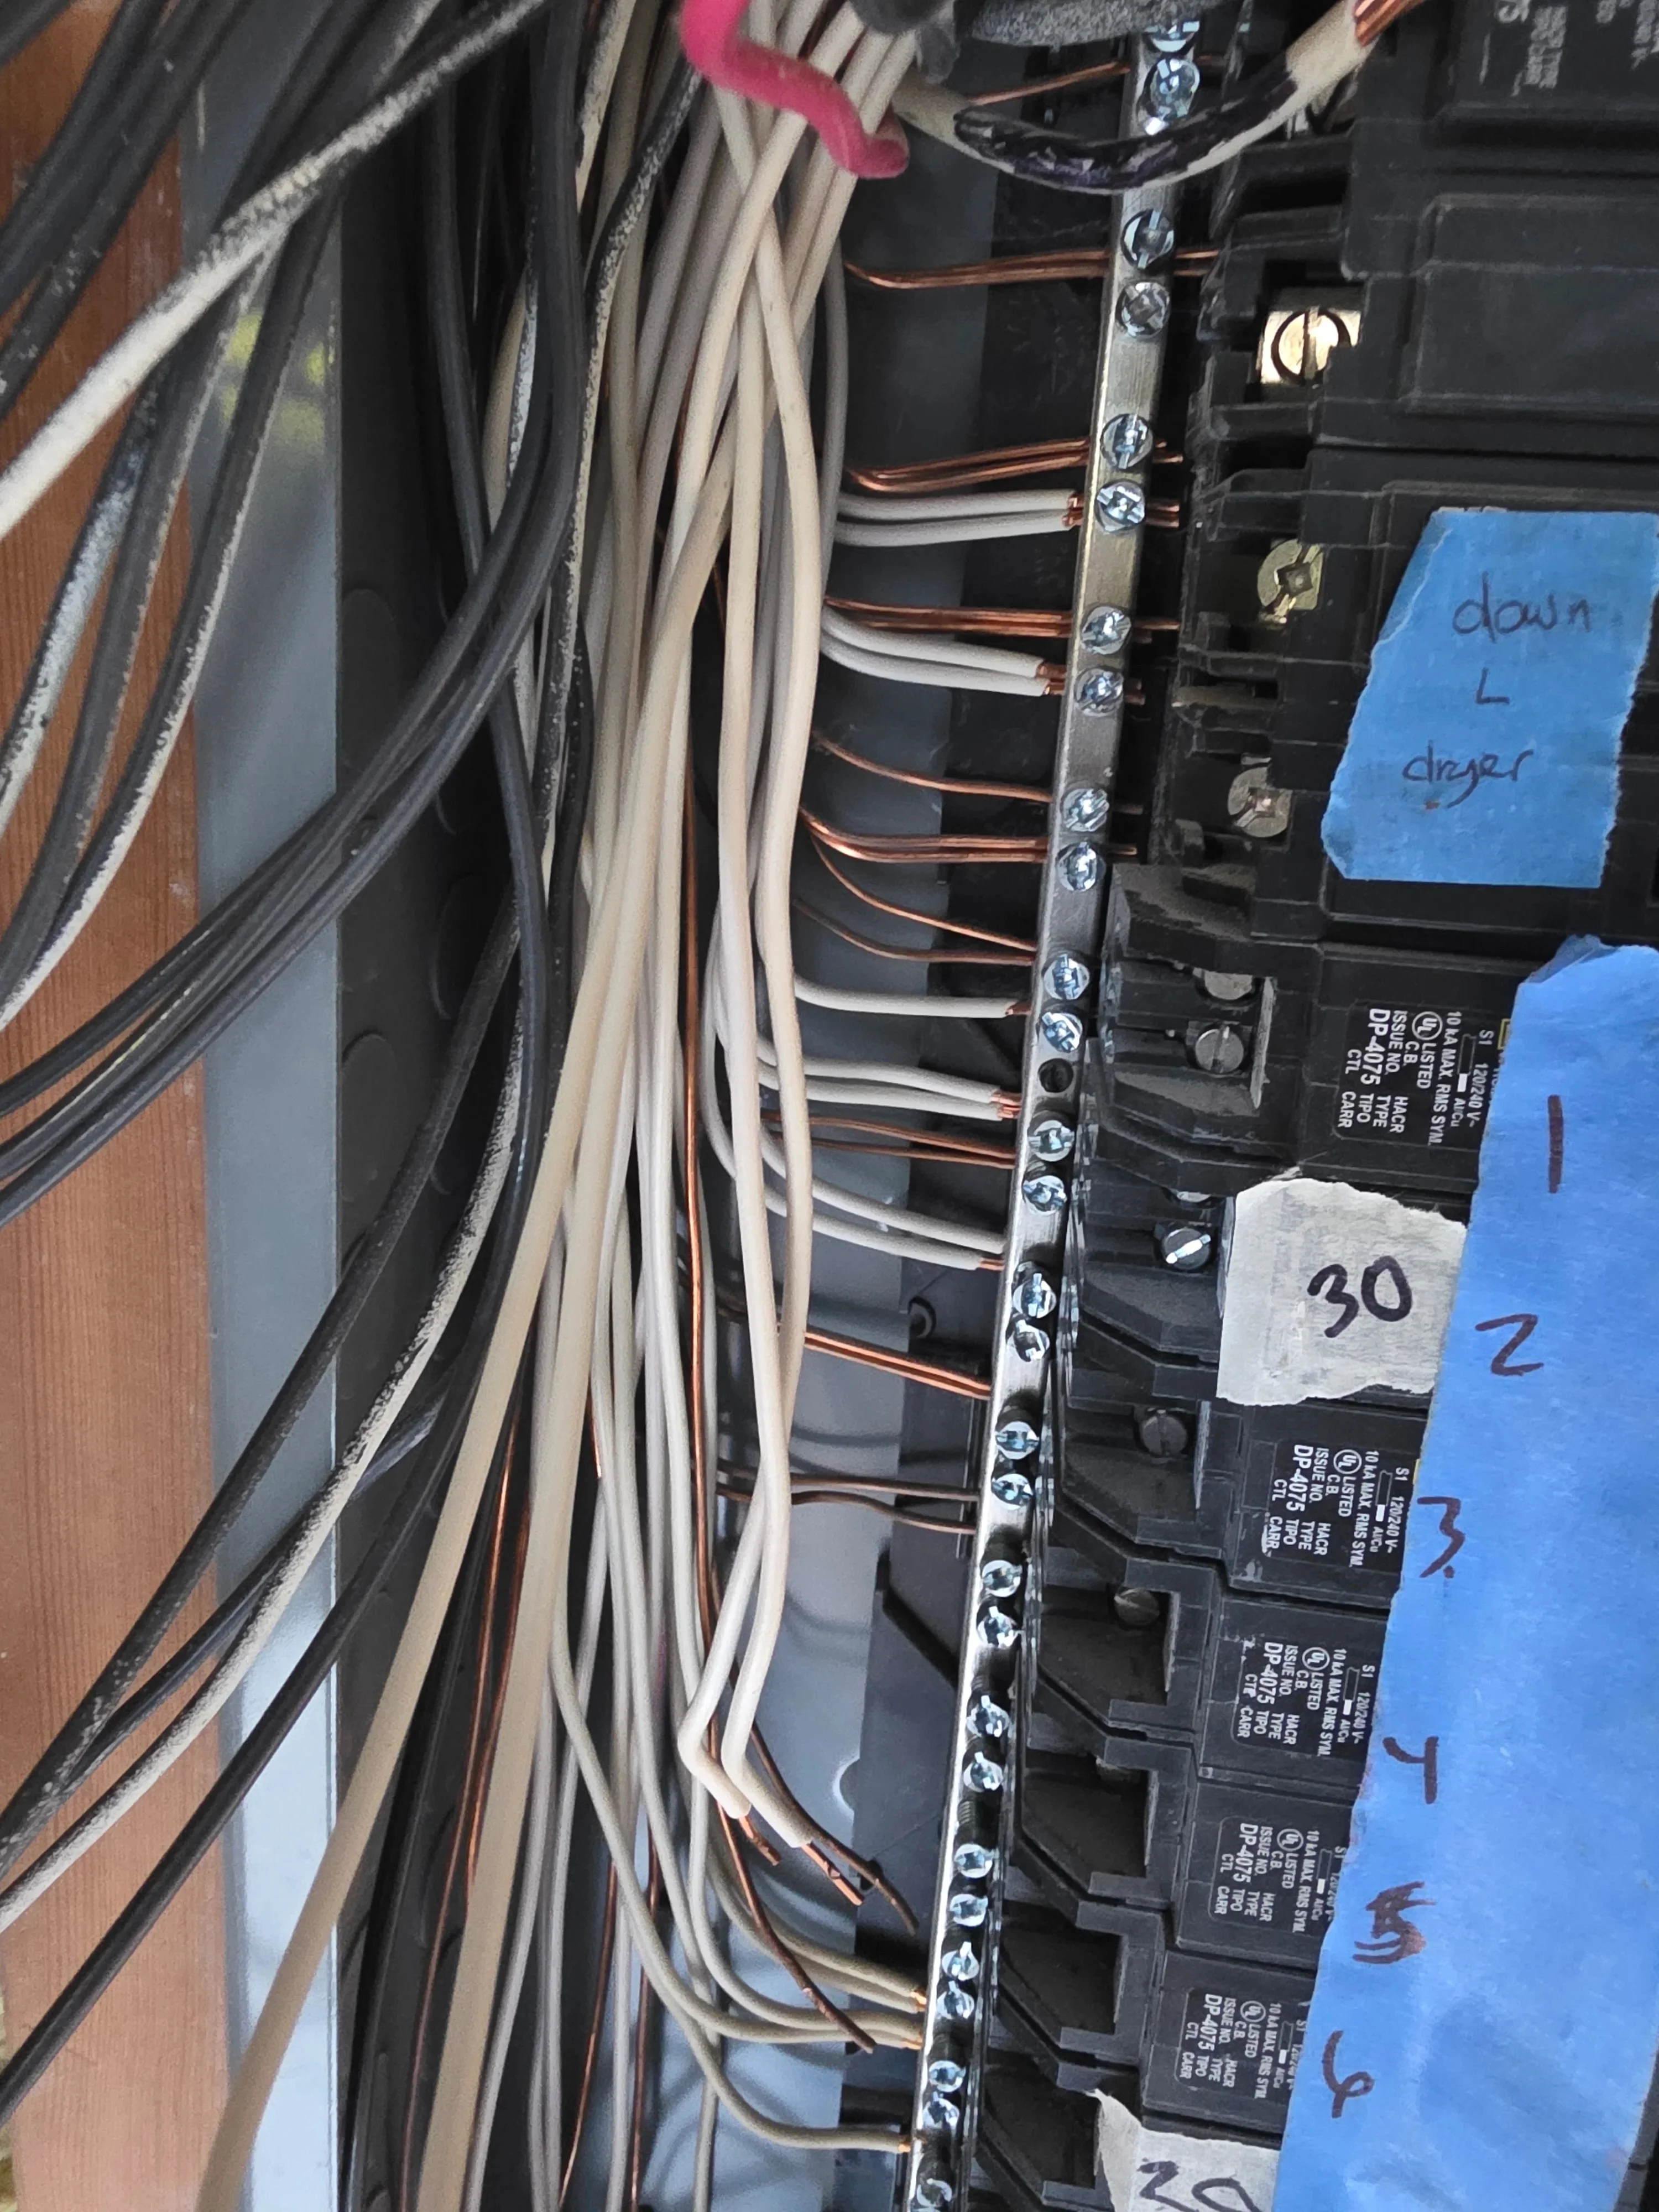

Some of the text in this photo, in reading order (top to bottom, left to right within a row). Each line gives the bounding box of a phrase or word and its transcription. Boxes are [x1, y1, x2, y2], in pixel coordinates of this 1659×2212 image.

[1452, 572, 1592, 644] down
[1475, 667, 1510, 704] L
[1402, 739, 1535, 809] dryer
[1389, 1010, 1407, 1050] ISSUE
[1447, 1011, 1462, 1025] 10
[1360, 1009, 1391, 1085] DP-4075
[1443, 1029, 1459, 1046] kA
[1479, 1030, 1494, 1045] S1
[1345, 1049, 1362, 1074] CTL
[1404, 1041, 1420, 1066] C.B.
[1417, 1043, 1437, 1089] LISTED
[1433, 1084, 1452, 1112] RMS
[1468, 1063, 1489, 1109] 120/240
[1338, 1092, 1357, 1128] CARR
[1357, 1093, 1375, 1123] TIPO
[1373, 1095, 1391, 1128] TYPE
[1390, 1097, 1408, 1133] HACR
[1307, 1255, 1413, 1338] 30
[1475, 1313, 1544, 1376] 2
[1312, 1448, 1329, 1481] ISSUE
[1365, 1451, 1379, 1463] 10
[1286, 1444, 1314, 1512] DP-4075
[1325, 1474, 1341, 1496] C.B.
[1363, 1465, 1378, 1480] kA
[1395, 1467, 1410, 1481] S1
[1272, 1479, 1288, 1501] CTL
[1338, 1476, 1357, 1517] LISTED
[1354, 1513, 1370, 1538] RMS
[1386, 1496, 1405, 1537] 120/240
[1265, 1516, 1283, 1549] CARR
[1283, 1519, 1300, 1545] TIPO
[1298, 1521, 1316, 1551] TYPE
[1314, 1523, 1332, 1556] HACR
[1282, 1645, 1298, 1677] ISSUE
[1330, 1662, 1344, 1676] kA
[1333, 1649, 1347, 1660] 10
[1257, 1642, 1284, 1704] DP-4075
[1307, 1672, 1324, 1710] LISTED
[1238, 1707, 1254, 1738] CARR
[1254, 1710, 1270, 1735] TIPO
[1269, 1713, 1285, 1740] TYPE
[1283, 1714, 1300, 1745] HACR
[1322, 1707, 1338, 1730] RMS
[1383, 1736, 1439, 1805] 4
[1257, 1827, 1274, 1857] ISSUE
[1307, 1830, 1320, 1842] 10
[1220, 1854, 1235, 1873] CTL
[1233, 1823, 1259, 1883] DP-4075
[1282, 1853, 1299, 1889] LISTED
[1214, 1886, 1230, 1914] CARR
[1230, 1889, 1246, 1912] TIPO
[1244, 1892, 1260, 1917] TYPE
[1260, 1893, 1275, 1922] HACR
[1296, 1886, 1312, 1908] RMS
[1198, 1994, 1223, 2051] DP-4075
[1221, 1997, 1237, 2027] ISSUE
[1245, 2023, 1261, 2058] LISTED
[1209, 2058, 1224, 2082] TYPE
[1322, 2030, 1375, 2119] 6
